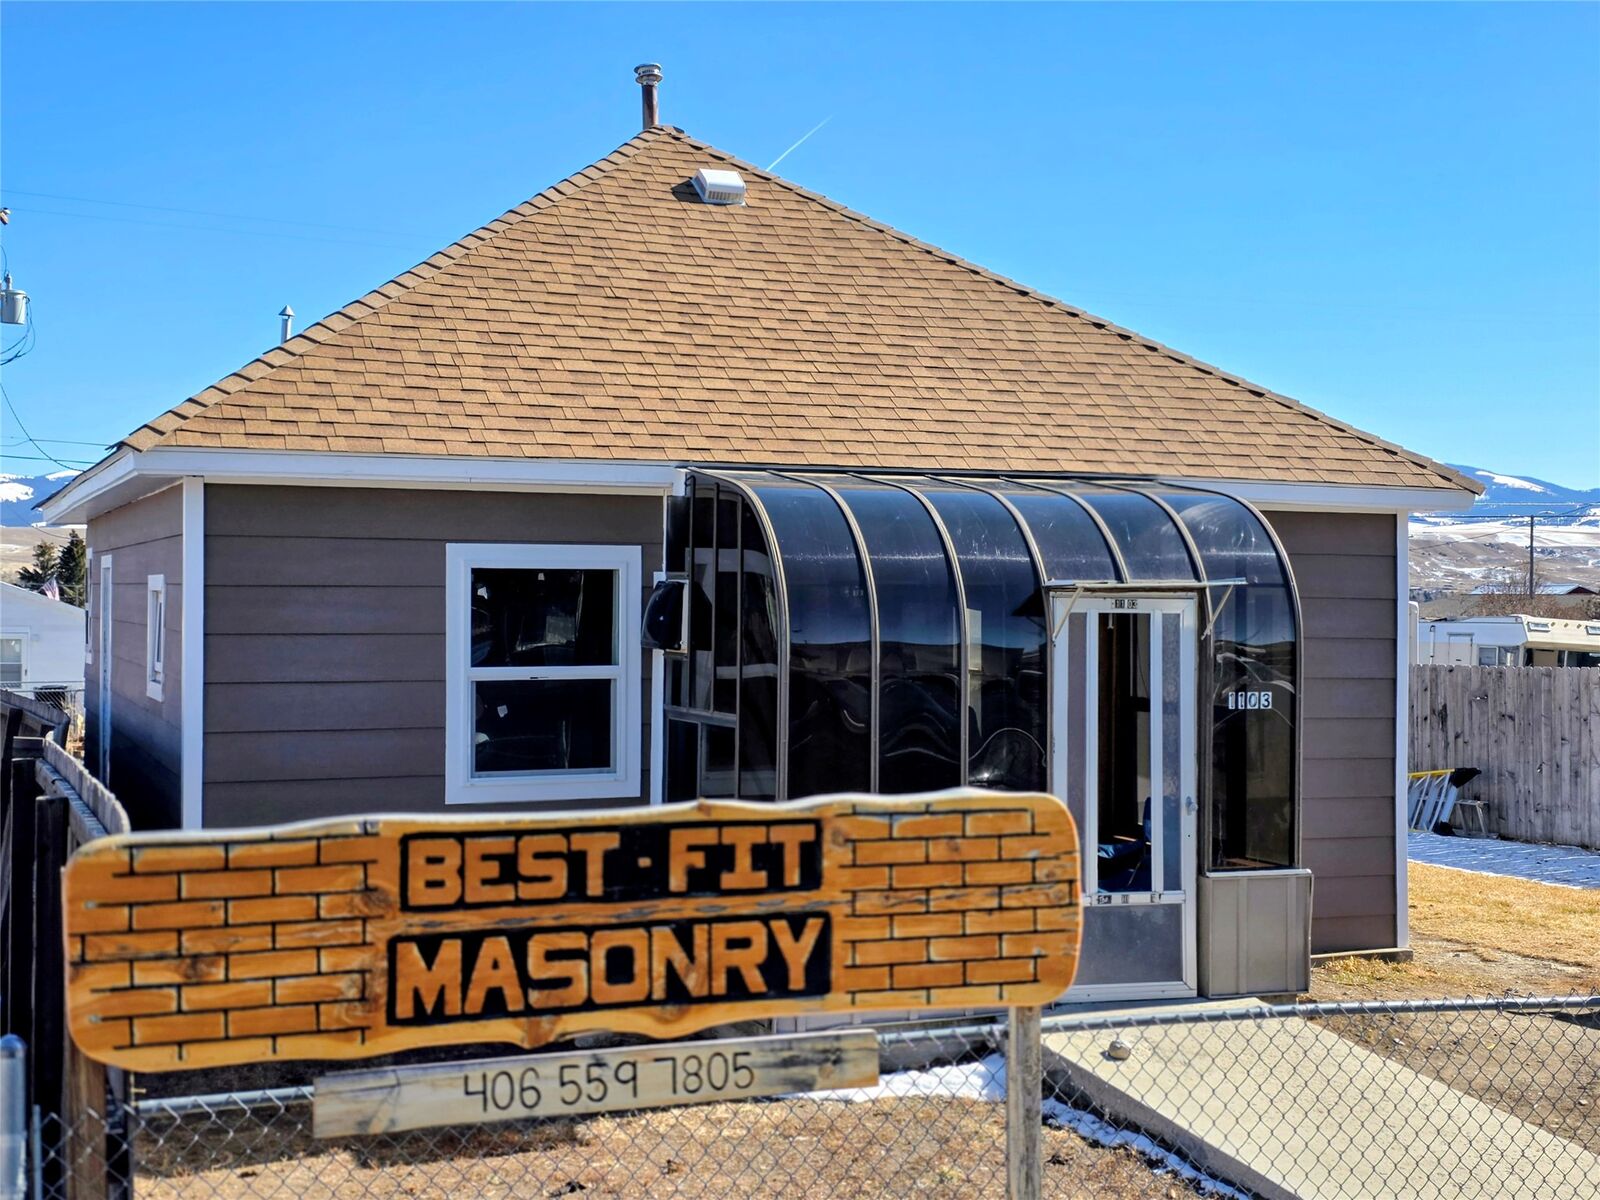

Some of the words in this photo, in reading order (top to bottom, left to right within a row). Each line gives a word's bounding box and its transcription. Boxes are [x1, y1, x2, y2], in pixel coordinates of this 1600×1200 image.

[1228, 691, 1273, 709] 1103
[406, 831, 621, 907] BEST
[668, 824, 816, 893] FIT
[394, 917, 826, 1021] MASONRY
[462, 1066, 542, 1113] 406
[557, 1059, 639, 1106] 559
[652, 1051, 756, 1096] 7805
